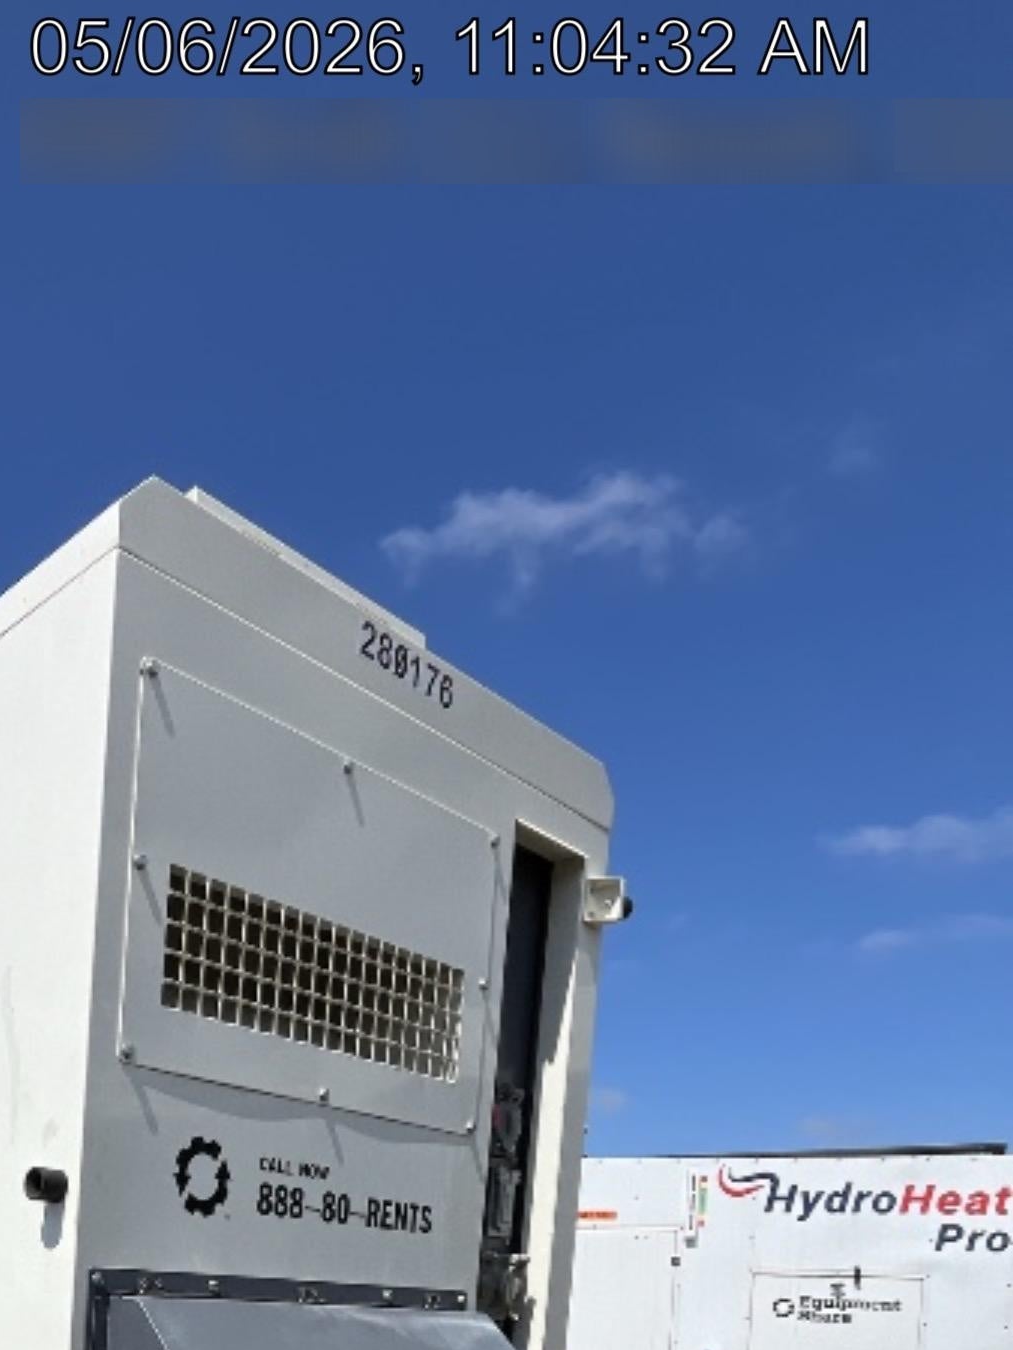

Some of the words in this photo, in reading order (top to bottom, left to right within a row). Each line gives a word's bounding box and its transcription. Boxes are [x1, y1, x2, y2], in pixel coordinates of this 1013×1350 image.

[361, 620, 453, 709] 280176
[256, 1182, 432, 1234] 888-80-RENTS
[763, 1182, 1013, 1222] HydroHeat
